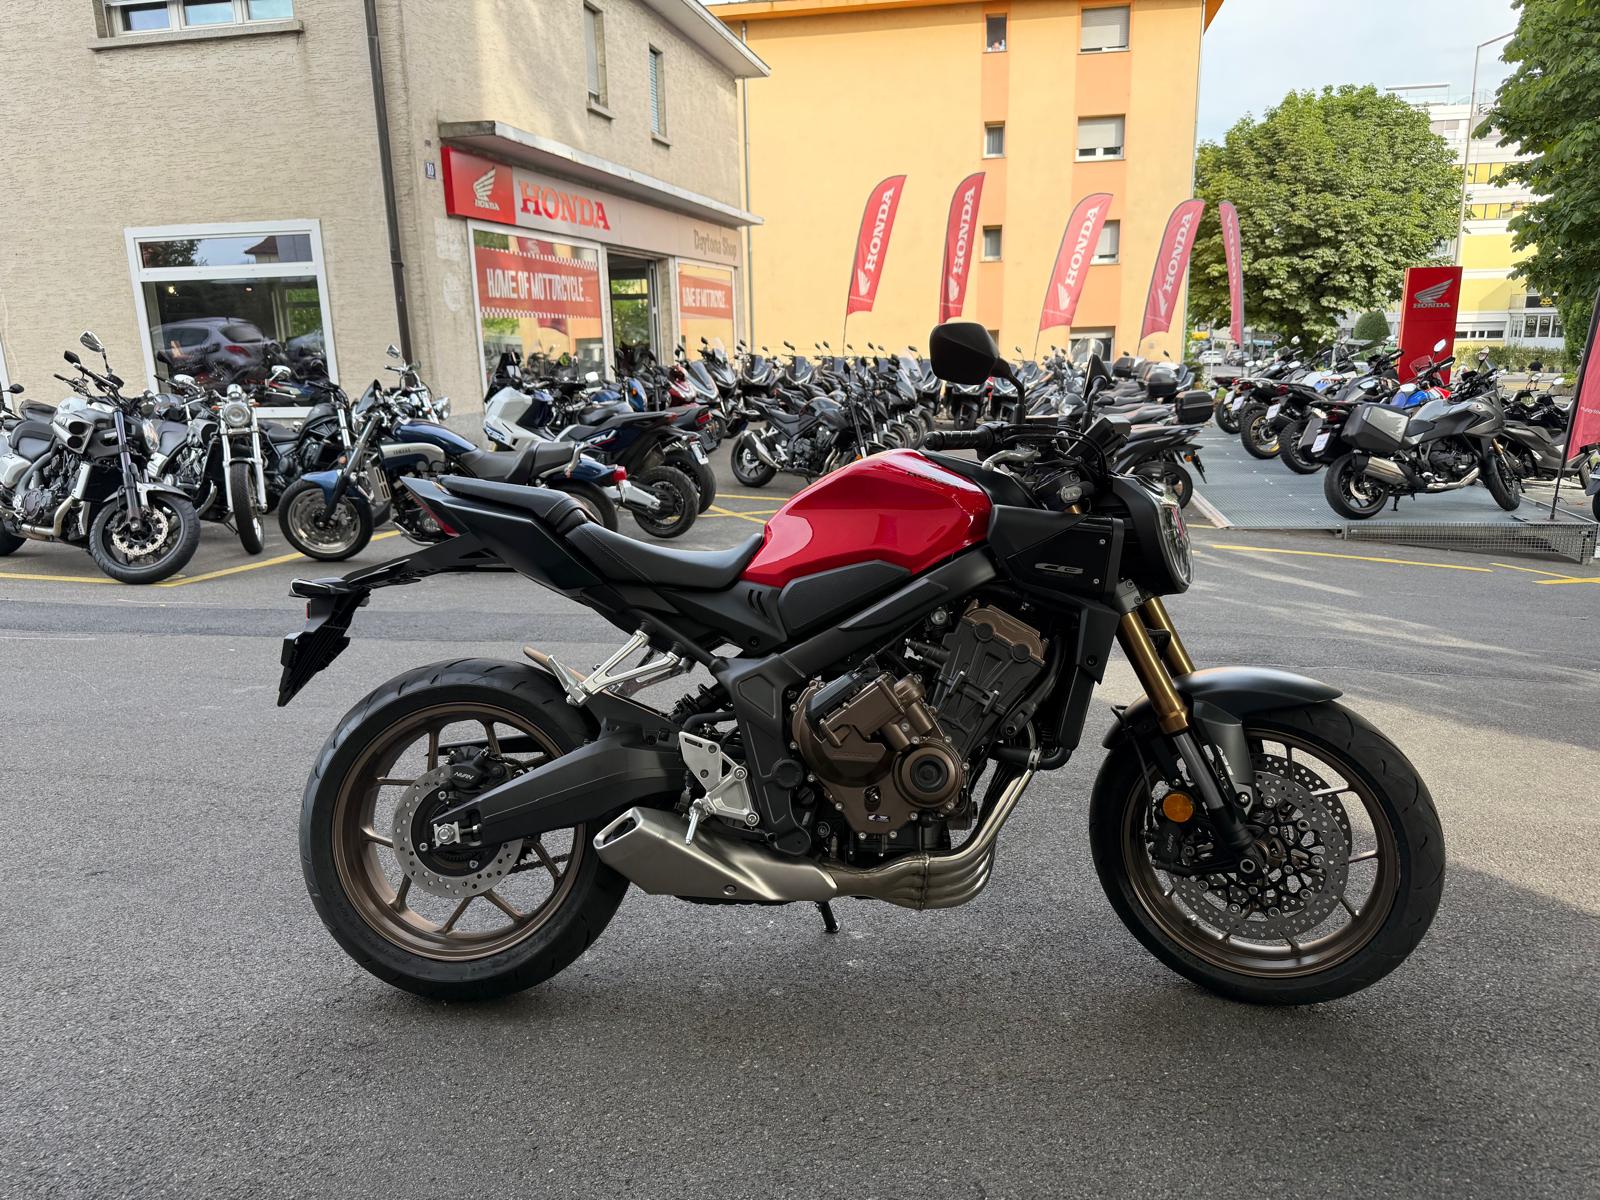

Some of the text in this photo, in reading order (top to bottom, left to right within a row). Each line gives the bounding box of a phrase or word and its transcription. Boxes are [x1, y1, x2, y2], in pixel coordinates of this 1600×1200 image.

[474, 198, 500, 211] HONDA
[518, 180, 611, 231] HONDA
[864, 186, 896, 273] HONDA
[952, 186, 976, 275] HONDA
[486, 268, 518, 299] HOME
[518, 270, 530, 300] OF
[1064, 205, 1100, 288] HONDA
[1162, 211, 1194, 294] HONDA
